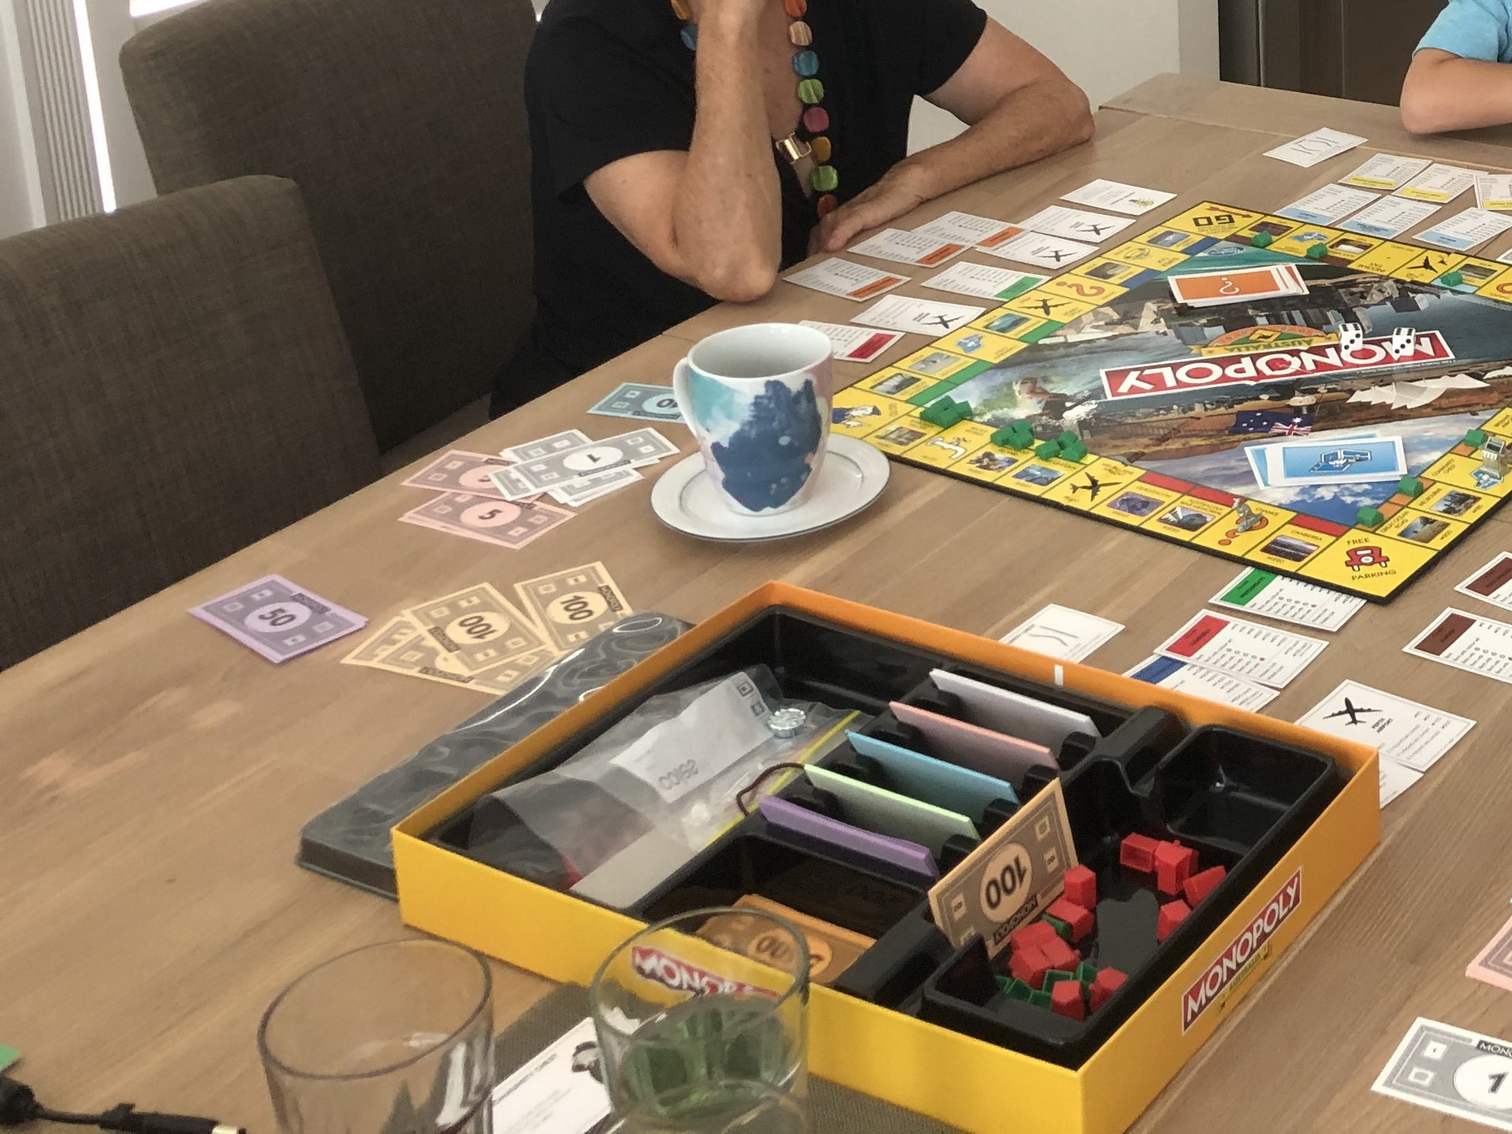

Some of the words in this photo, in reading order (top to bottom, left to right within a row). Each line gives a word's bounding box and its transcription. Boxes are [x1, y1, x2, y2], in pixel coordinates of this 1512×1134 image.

[1193, 214, 1235, 228] GO
[1226, 339, 1314, 354] AUSTRALIA
[1116, 335, 1438, 394] MONOPOLY
[478, 508, 504, 521] 5
[1346, 537, 1371, 546] FREE
[1351, 568, 1398, 582] PARKING
[257, 607, 297, 627] 50
[559, 594, 594, 621] 100
[458, 615, 498, 640] 100
[985, 853, 1028, 911] 100
[1186, 876, 1299, 1024] MONOPOLY
[1487, 1071, 1510, 1094] 1
